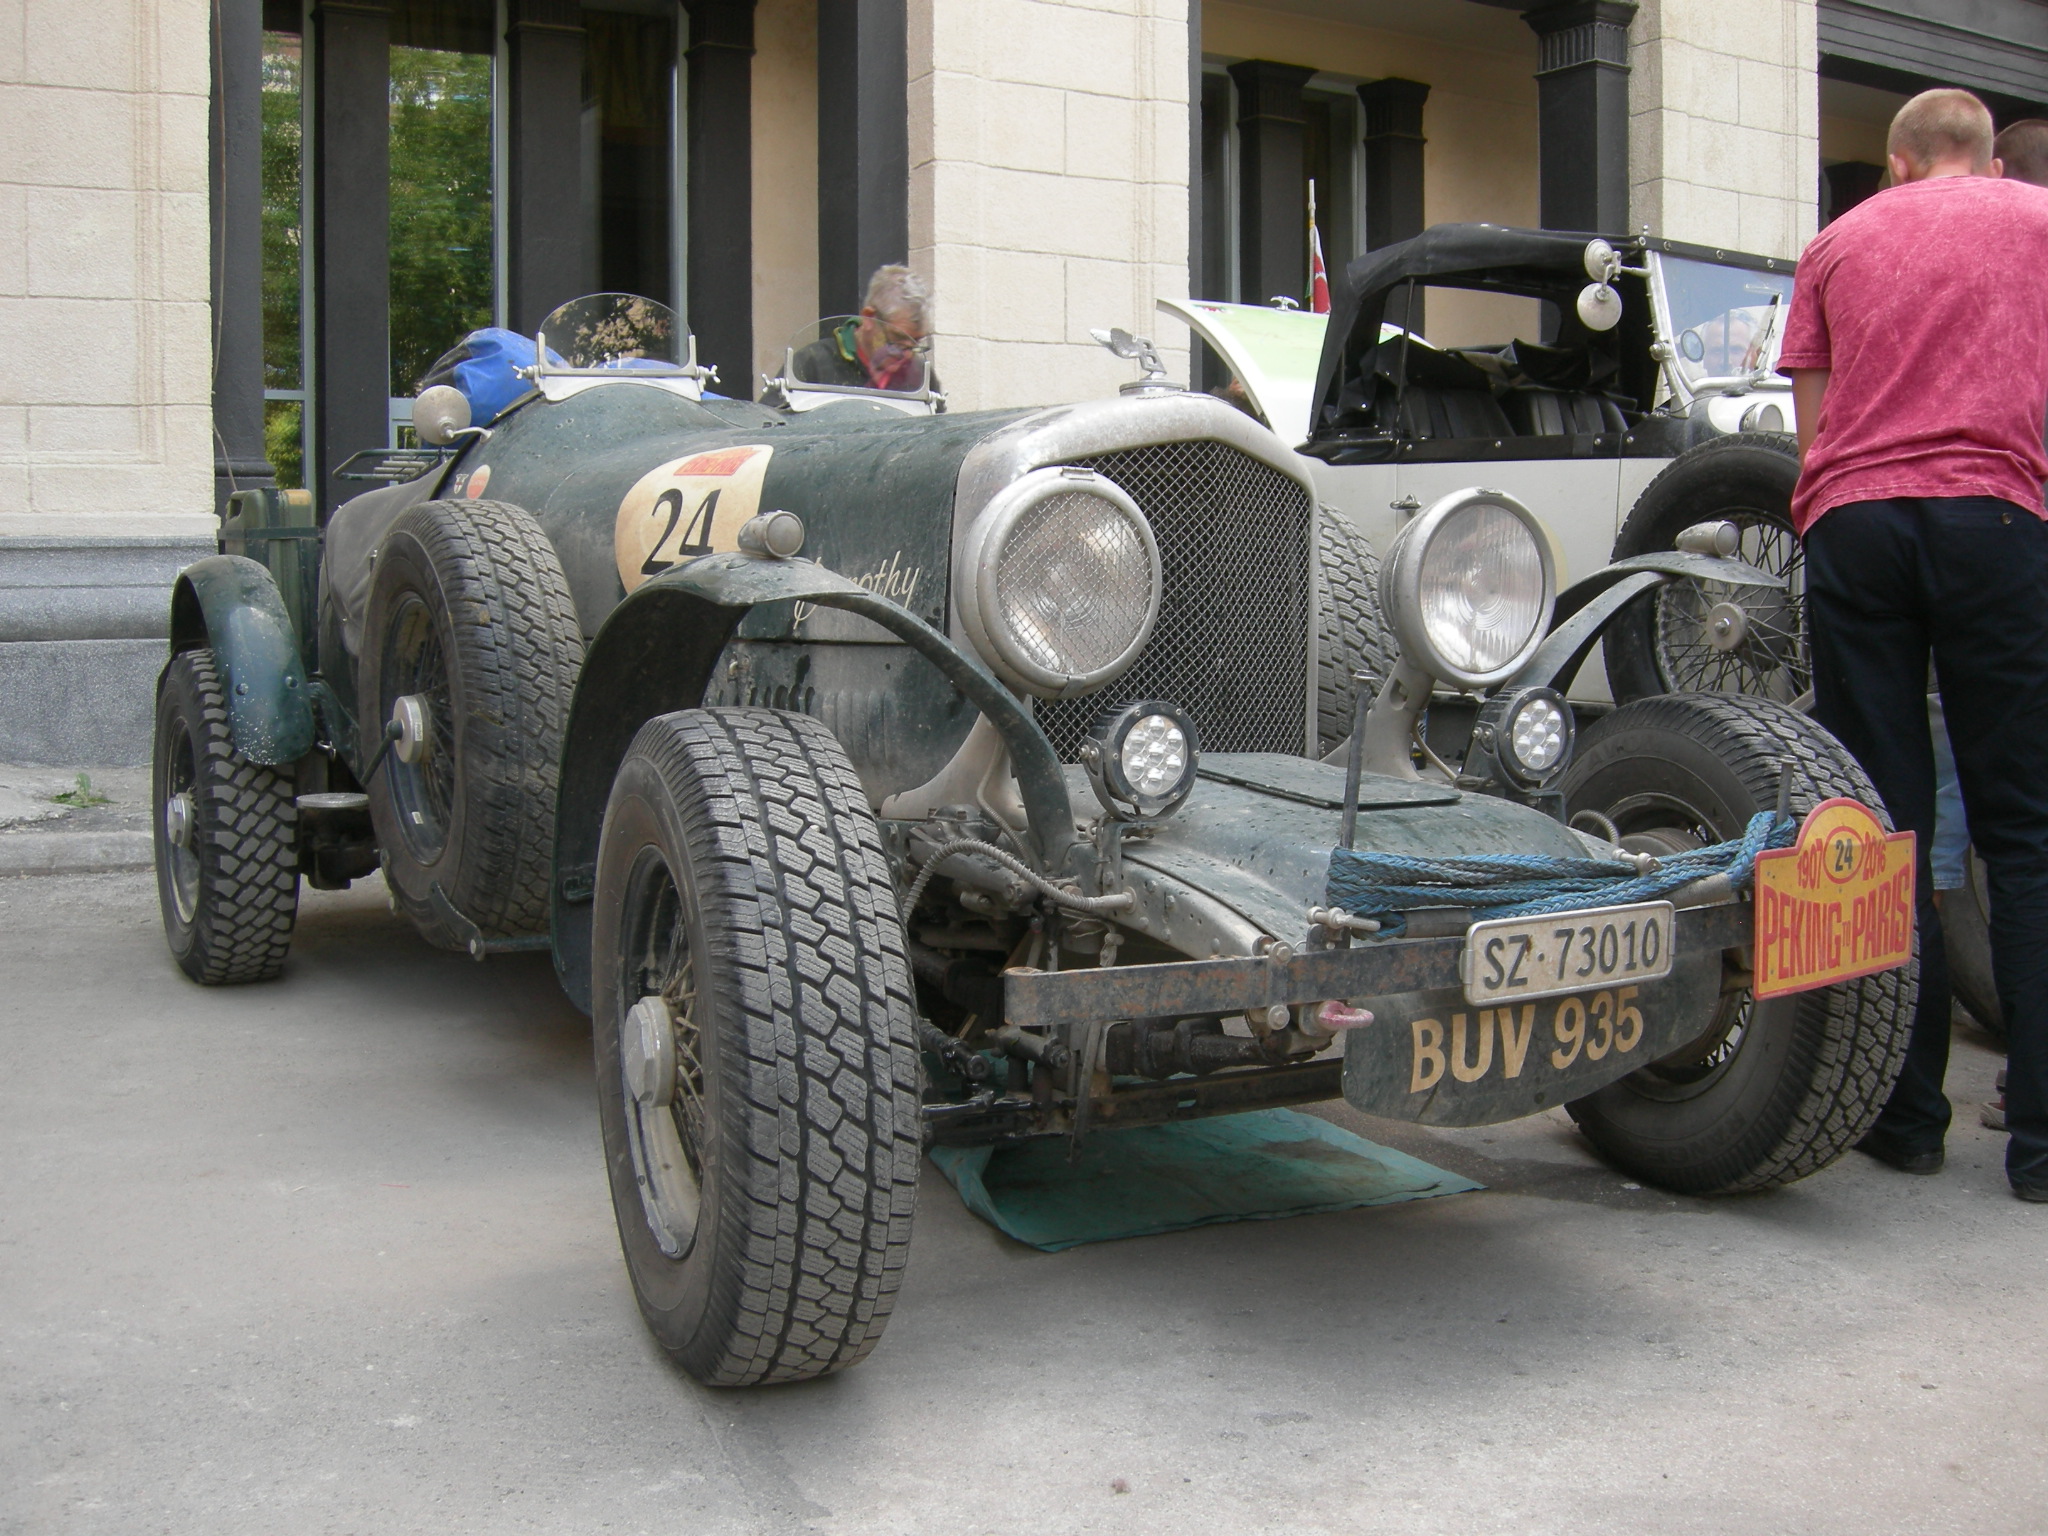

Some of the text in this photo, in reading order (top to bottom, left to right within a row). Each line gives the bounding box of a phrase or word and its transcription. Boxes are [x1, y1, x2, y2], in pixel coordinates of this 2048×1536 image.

[641, 488, 722, 576] 24
[1797, 831, 1886, 889] 1907 24 2016
[1761, 884, 1842, 983] PEKING
[1851, 863, 1910, 963] PARIS
[1411, 986, 1644, 1093] BUV 935
